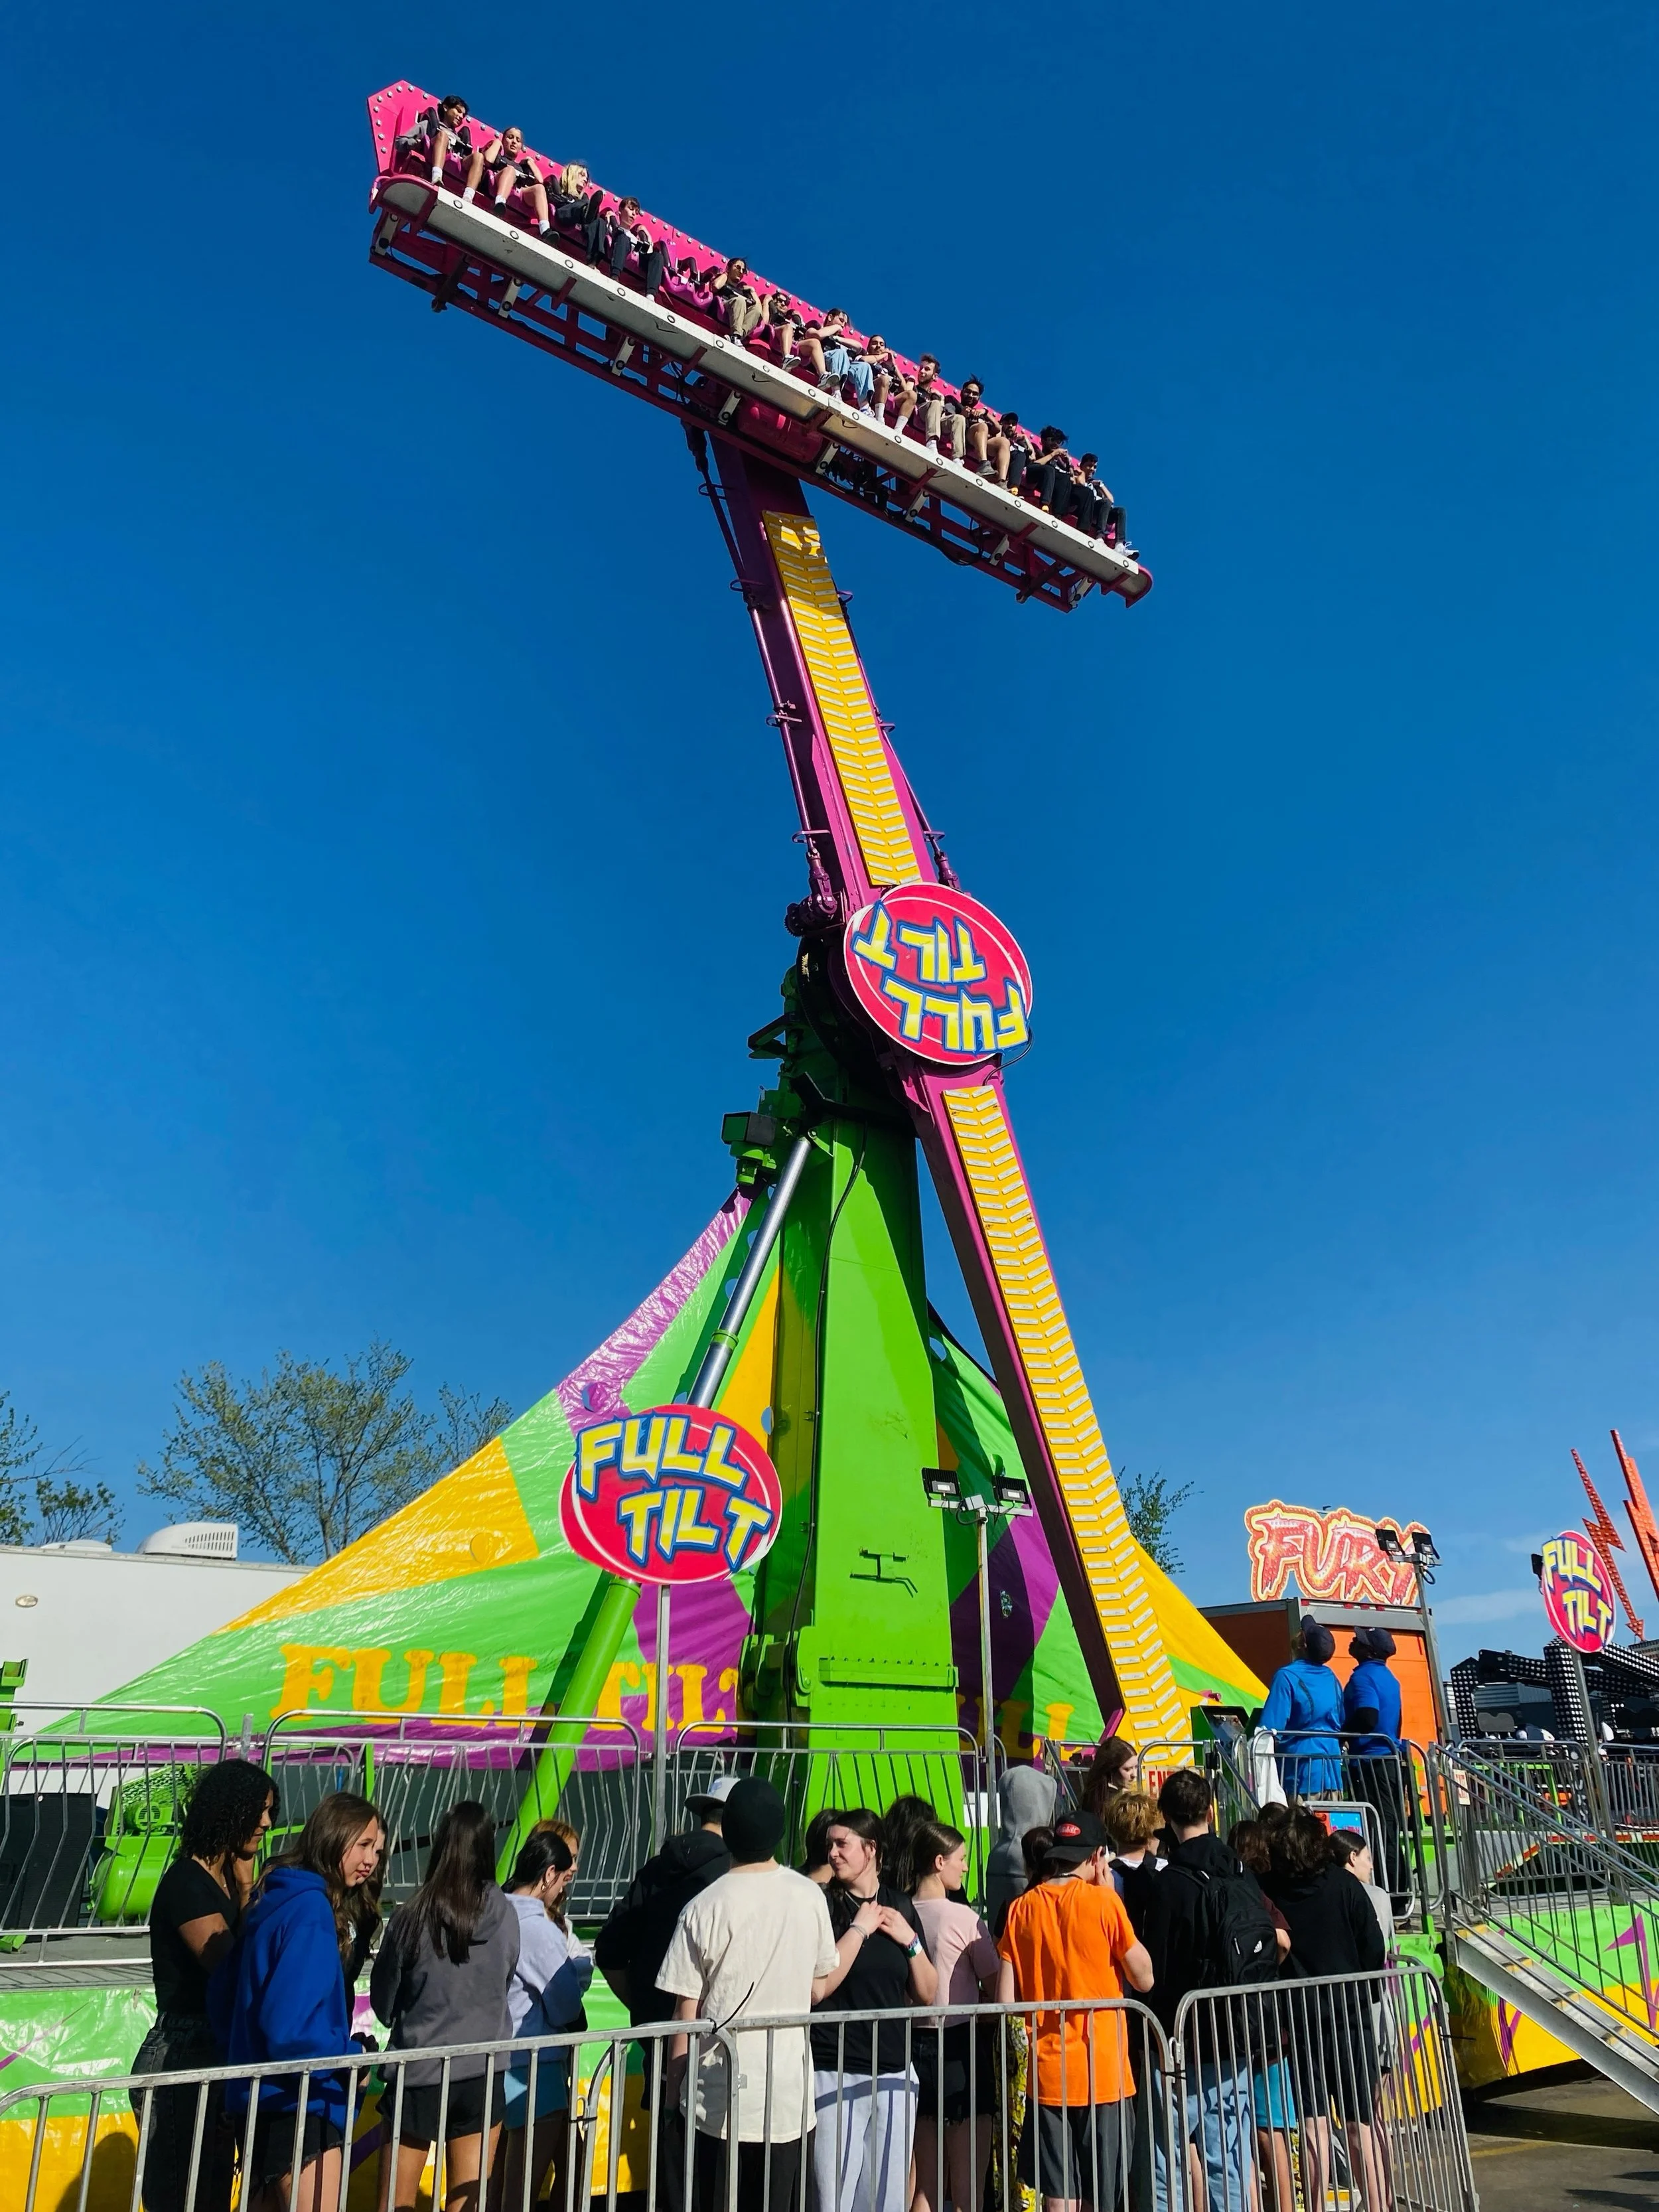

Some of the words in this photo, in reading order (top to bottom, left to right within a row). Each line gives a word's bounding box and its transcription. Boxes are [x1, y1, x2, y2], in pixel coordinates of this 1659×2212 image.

[852, 901, 987, 986] TILT
[883, 979, 1030, 1054] FULL
[577, 1414, 748, 1500] FULL
[618, 1486, 773, 1570] TILT
[1248, 1503, 1425, 1604] FURY
[1542, 1536, 1603, 1593] FULL
[1561, 1587, 1613, 1647] TILT
[956, 1694, 1083, 1761] ULL
